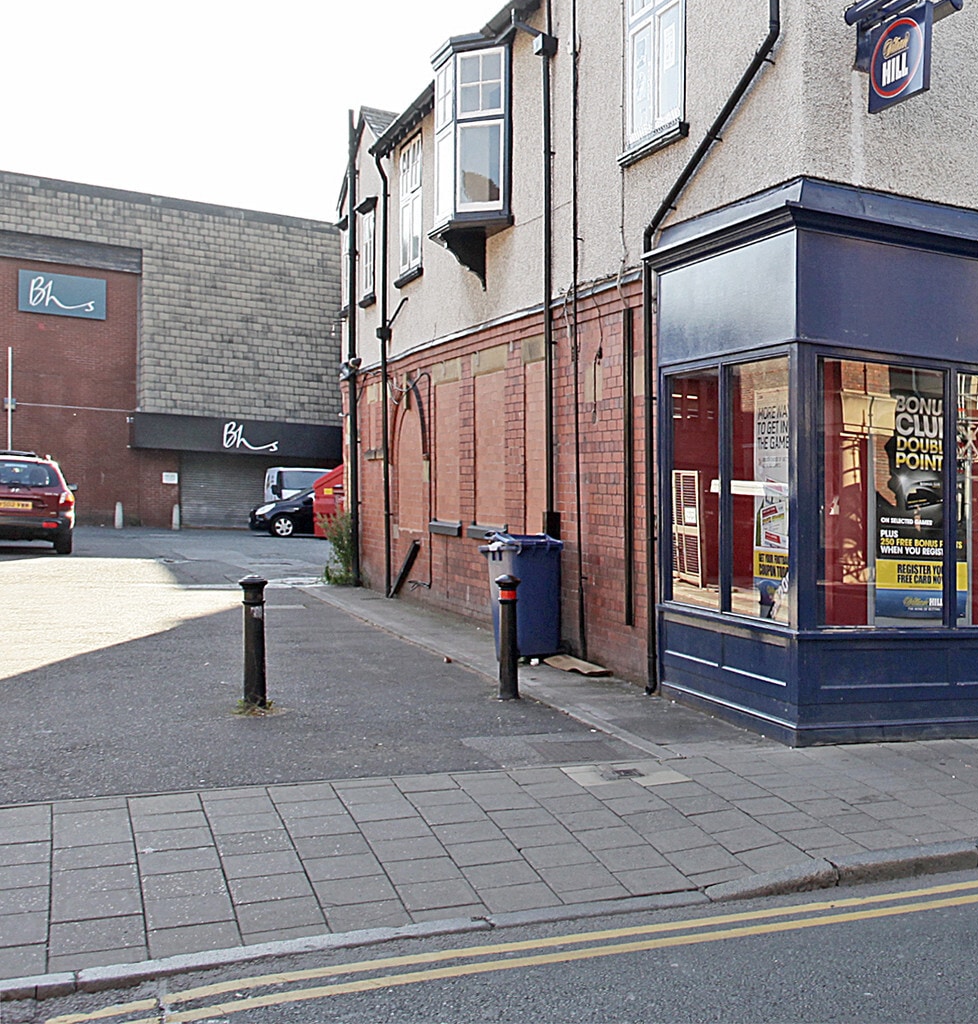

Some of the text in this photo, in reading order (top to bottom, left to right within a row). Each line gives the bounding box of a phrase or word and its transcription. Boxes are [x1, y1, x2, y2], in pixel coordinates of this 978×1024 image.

[881, 52, 909, 87] HILL
[28, 276, 95, 312] Bhs
[896, 395, 943, 416] BONU
[757, 422, 766, 435] TO
[767, 420, 779, 435] GET
[222, 421, 279, 452] Bhs
[757, 437, 768, 449] THE
[896, 436, 943, 455] DOUBL
[895, 452, 944, 472] POINT
[890, 517, 913, 525] SELECTED
[880, 529, 899, 538] PLUS
[880, 538, 895, 546] 250
[896, 538, 913, 547] FREE
[914, 539, 938, 548] BONUS
[880, 546, 903, 554] WHEN
[904, 546, 921, 555] YOU
[897, 564, 931, 575] REGISTER
[897, 574, 912, 584] FREE
[913, 575, 931, 585] CARD
[928, 597, 944, 607] HILL
